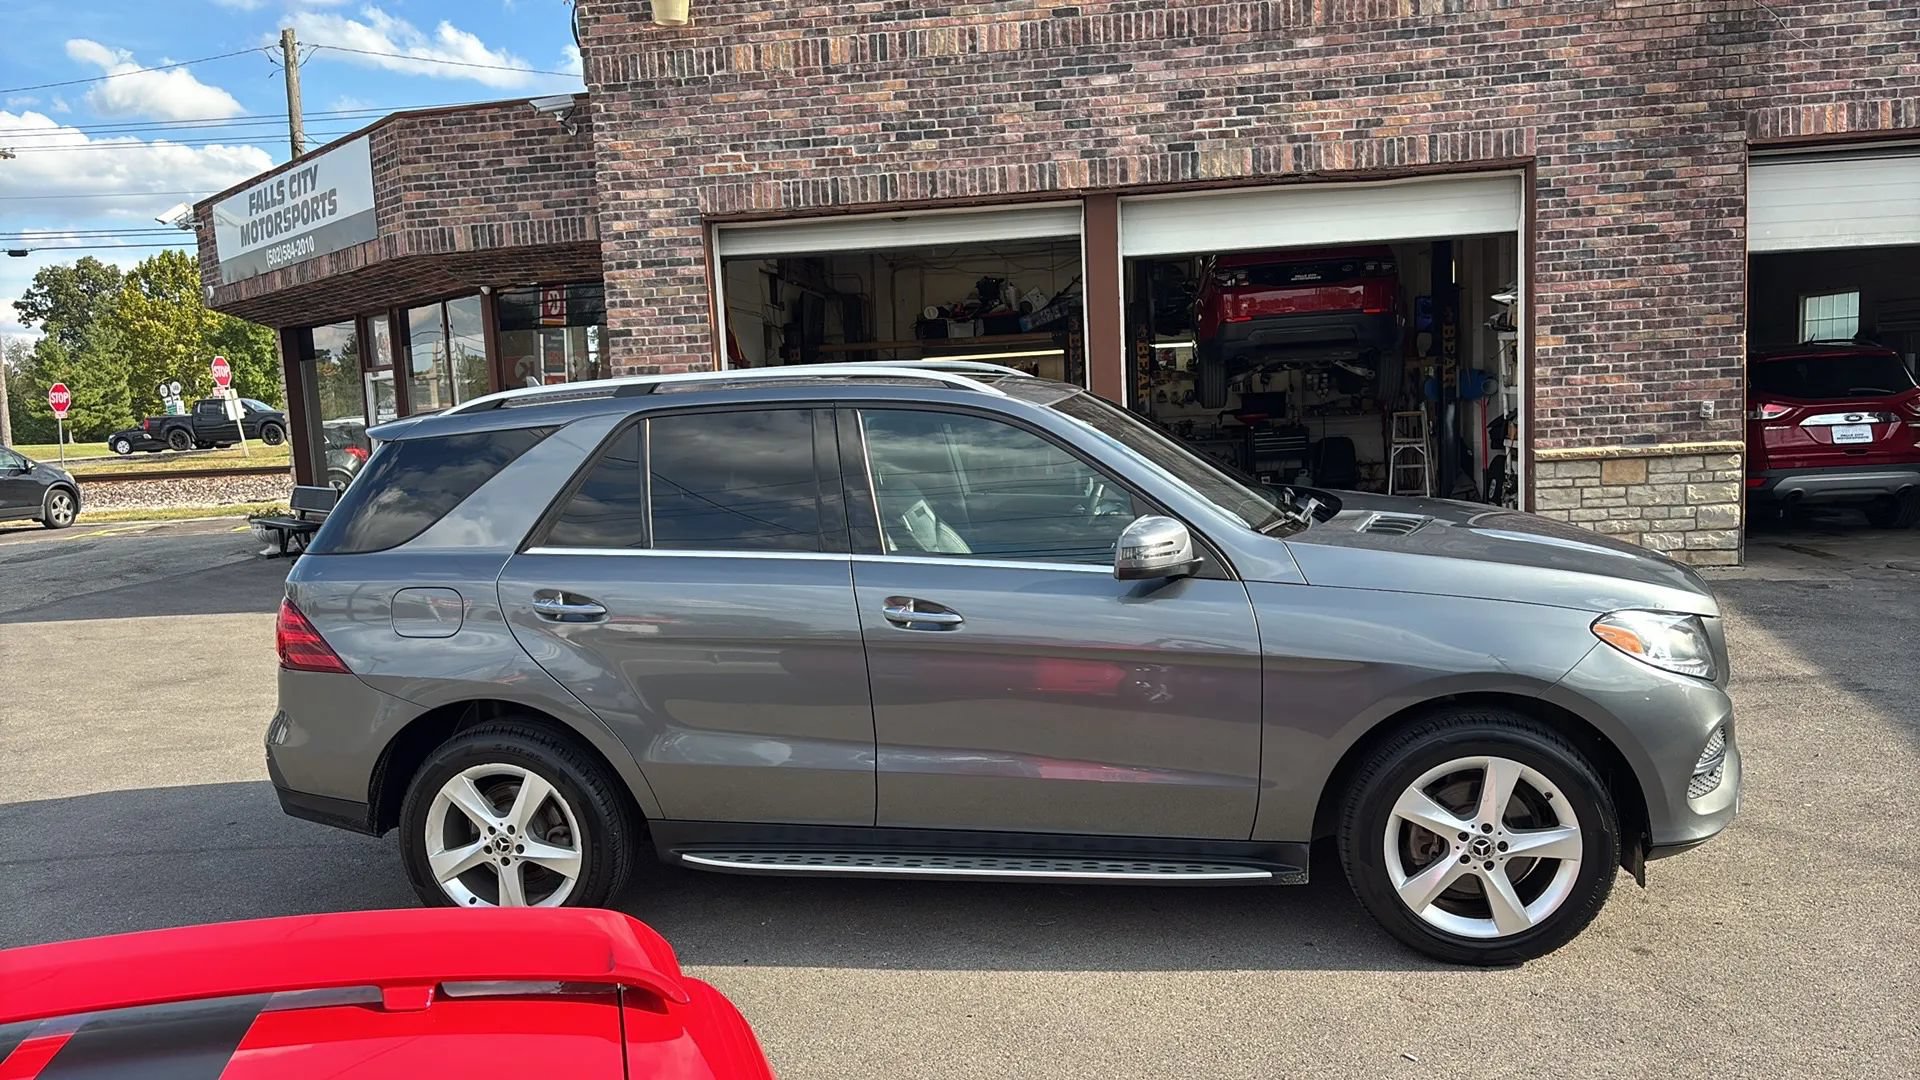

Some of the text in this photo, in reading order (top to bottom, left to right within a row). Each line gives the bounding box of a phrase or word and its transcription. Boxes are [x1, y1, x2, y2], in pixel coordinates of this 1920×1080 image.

[249, 164, 319, 217] FALLS CITY
[240, 188, 337, 248] MOTORSPORTS
[266, 235, 315, 268] (502)584-2010
[213, 365, 230, 378] STOP
[50, 391, 69, 404] STOP
